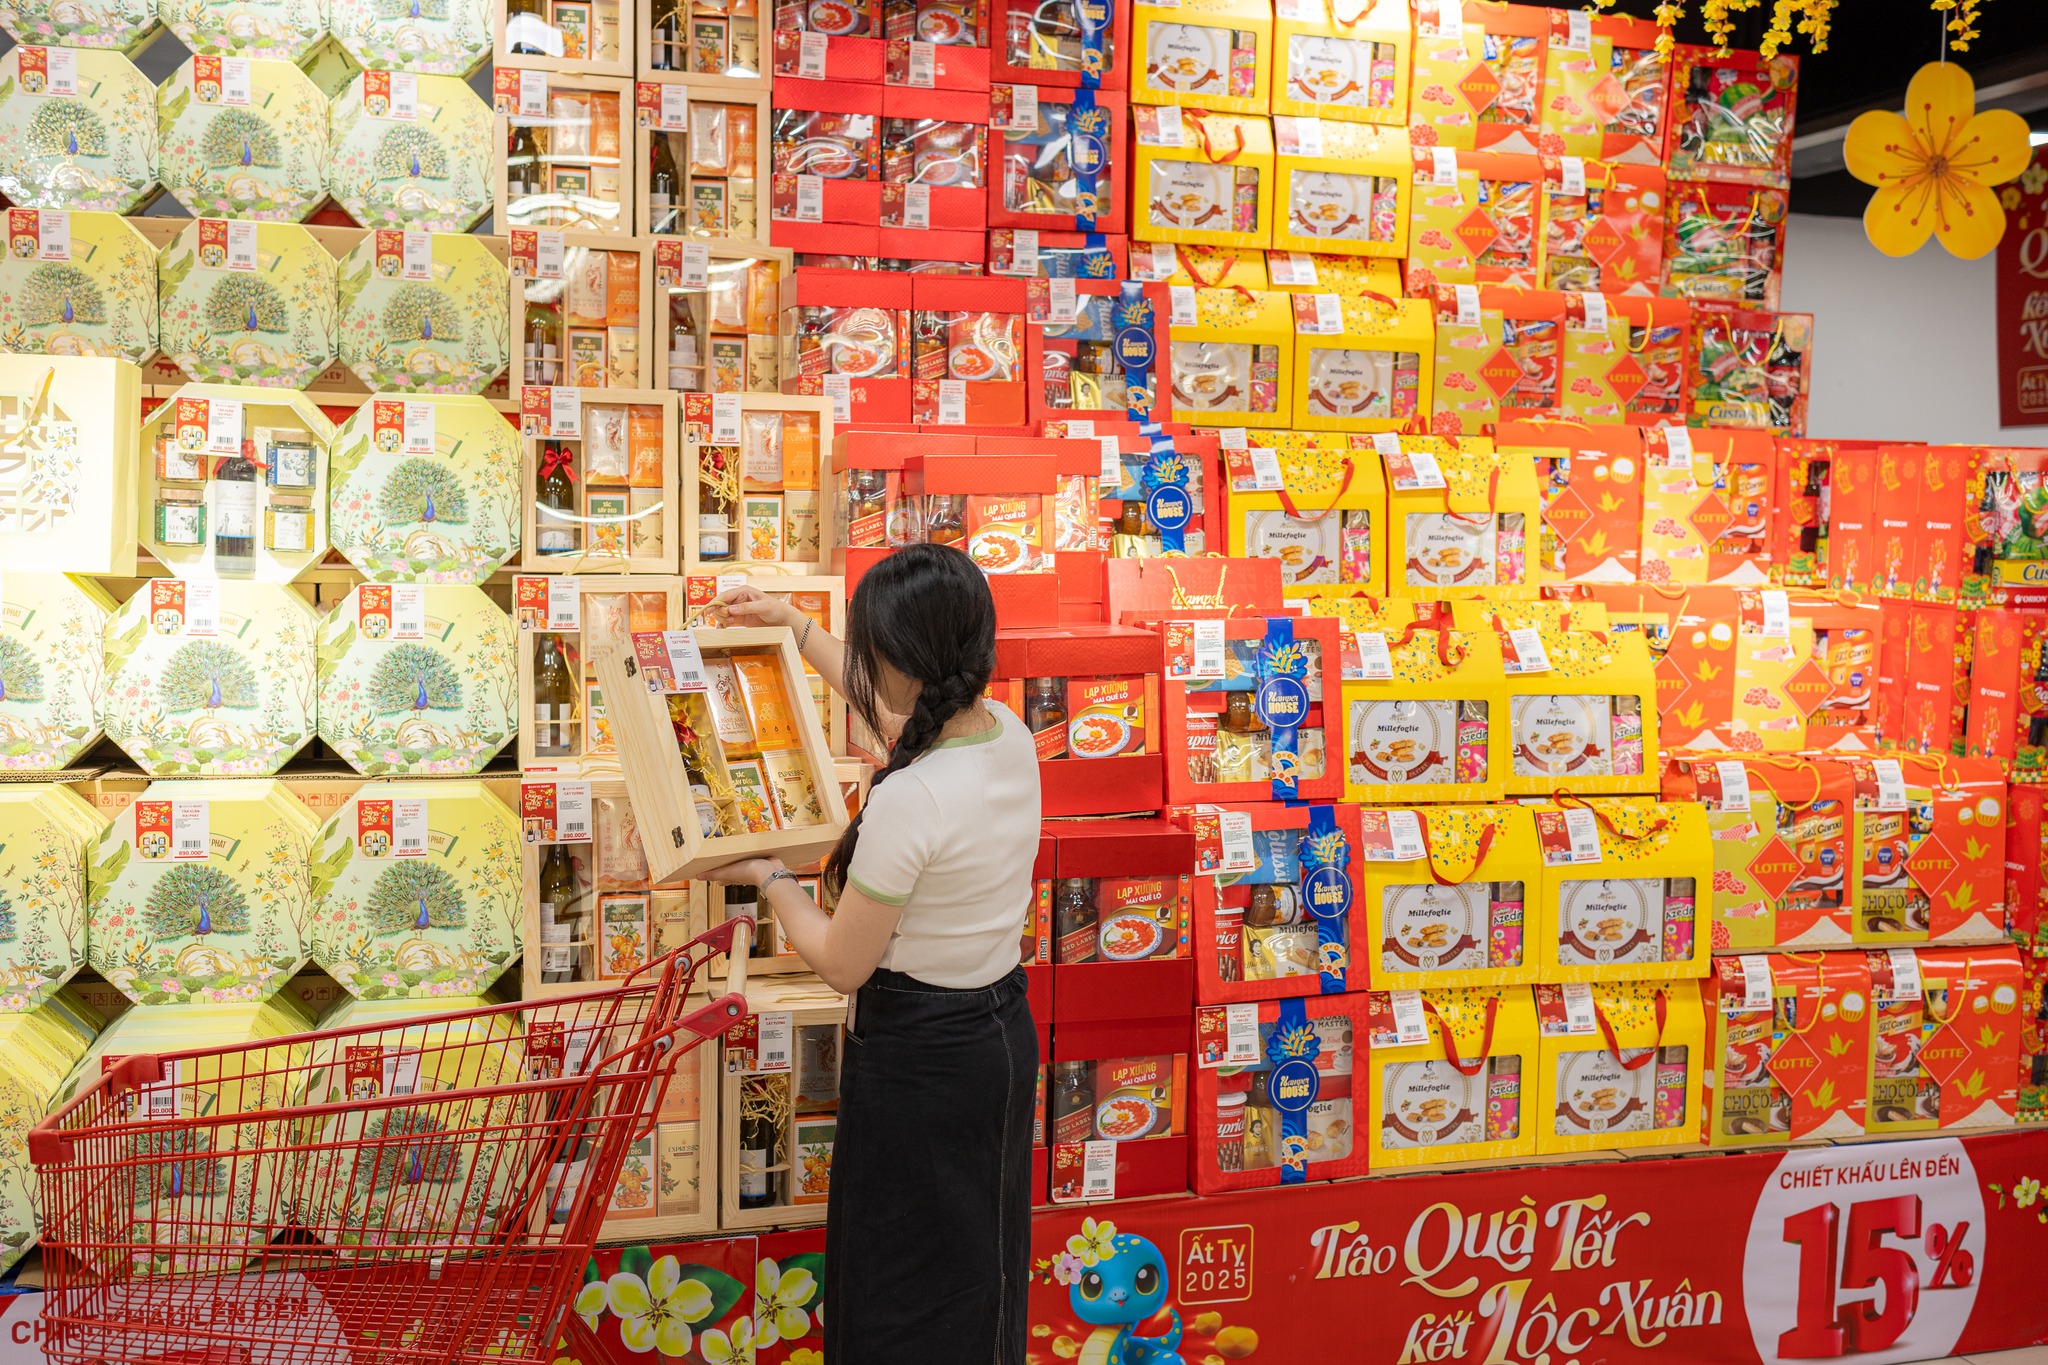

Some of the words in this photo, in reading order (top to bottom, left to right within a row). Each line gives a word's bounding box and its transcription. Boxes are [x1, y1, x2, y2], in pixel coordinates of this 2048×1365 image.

[1458, 225, 1495, 238] LOTTE
[1483, 367, 1518, 379] LOTTE
[1610, 372, 1643, 385] LOTTE
[1549, 508, 1588, 521] LOTTE
[1693, 512, 1729, 524] LOTTE
[851, 527, 865, 536] RED
[864, 521, 885, 532] LABEL
[1084, 686, 1100, 699] LẠP
[1789, 682, 1829, 693] LOTTE
[1268, 701, 1299, 714] HOUSE
[1377, 725, 1419, 733] Millefoglie
[1046, 732, 1066, 744] LABEL
[1754, 862, 1797, 874] LOTTE
[1911, 860, 1951, 871] LOTTE
[1117, 886, 1133, 900] LẠP
[1314, 892, 1344, 905] HOUSE
[1408, 908, 1452, 917] Millefoglie
[1585, 903, 1627, 912] Millefoglie
[1062, 943, 1075, 952] RED
[1076, 934, 1096, 948] LABEL
[1317, 1020, 1349, 1029] MASTER
[1922, 1047, 1964, 1060] LOTTE
[1772, 1057, 1814, 1070] LOTTE
[1112, 1068, 1128, 1082] LẠP
[1580, 1073, 1621, 1082] Millefoglie
[1280, 1085, 1310, 1099] HOUSE
[1407, 1083, 1451, 1092] Millefoglie
[1057, 1126, 1071, 1135] RED
[1071, 1116, 1091, 1130] LABEL
[1780, 1165, 1834, 1189] CHIẾT
[1837, 1160, 1885, 1185] KHẤU
[1890, 1158, 1921, 1181] LÊN
[1925, 1153, 1960, 1177] ĐẾN
[1310, 1220, 1397, 1280] Trao
[1400, 1194, 1538, 1298] Quà
[1545, 1194, 1650, 1272] Tết
[1186, 1237, 1215, 1267] Ất
[1218, 1237, 1246, 1270] Tỵ
[1186, 1266, 1246, 1293] 2025
[1396, 1310, 1476, 1365] kết
[1478, 1279, 1600, 1365] Lộc
[1599, 1277, 1722, 1348] Xuân
